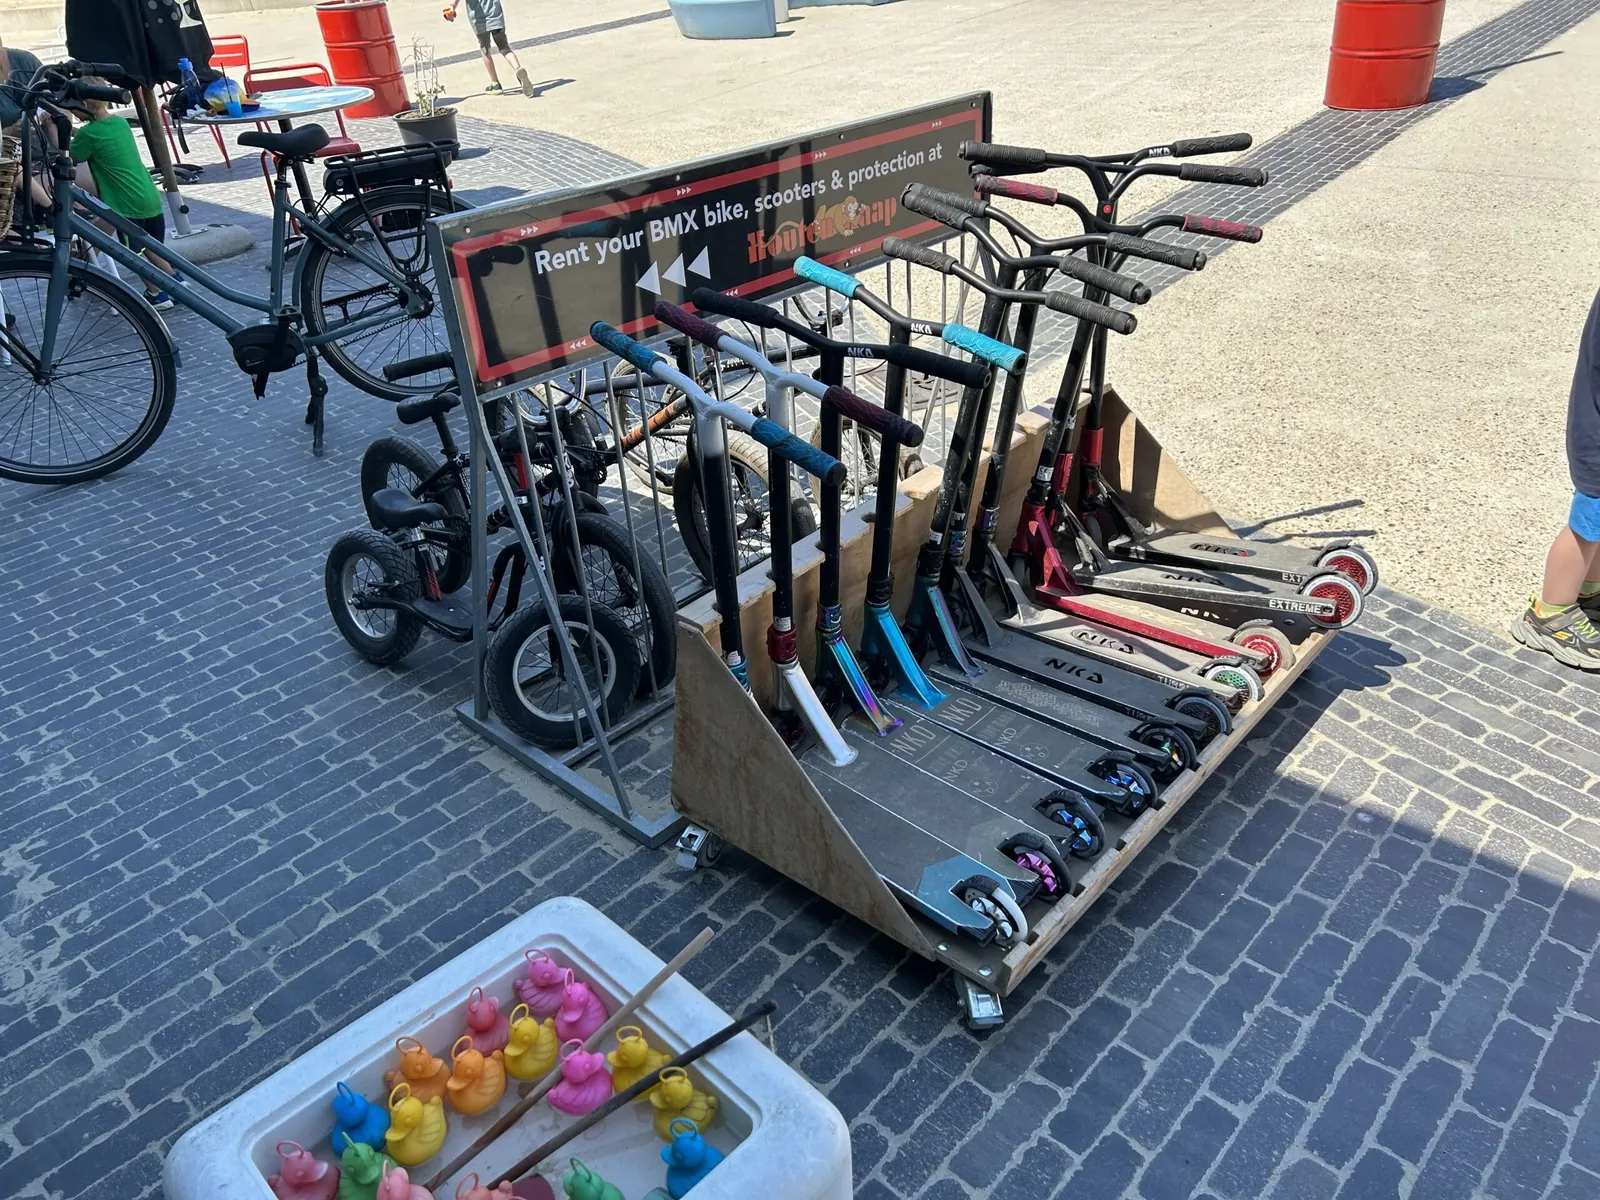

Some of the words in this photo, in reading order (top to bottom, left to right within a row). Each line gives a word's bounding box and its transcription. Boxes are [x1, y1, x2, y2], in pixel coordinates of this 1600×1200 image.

[534, 241, 590, 275] Rent
[594, 229, 645, 265] your
[649, 208, 700, 243] BMX
[703, 199, 750, 228] bike,
[754, 178, 826, 213] scooters
[830, 169, 844, 191] &
[848, 149, 925, 191] protection
[928, 142, 943, 161] at
[844, 197, 898, 231] aap
[1268, 599, 1323, 614] EXTREME
[938, 697, 983, 726] NKD
[889, 723, 937, 757] NKD
[993, 727, 1017, 749] NKD
[943, 759, 968, 783] NKD
